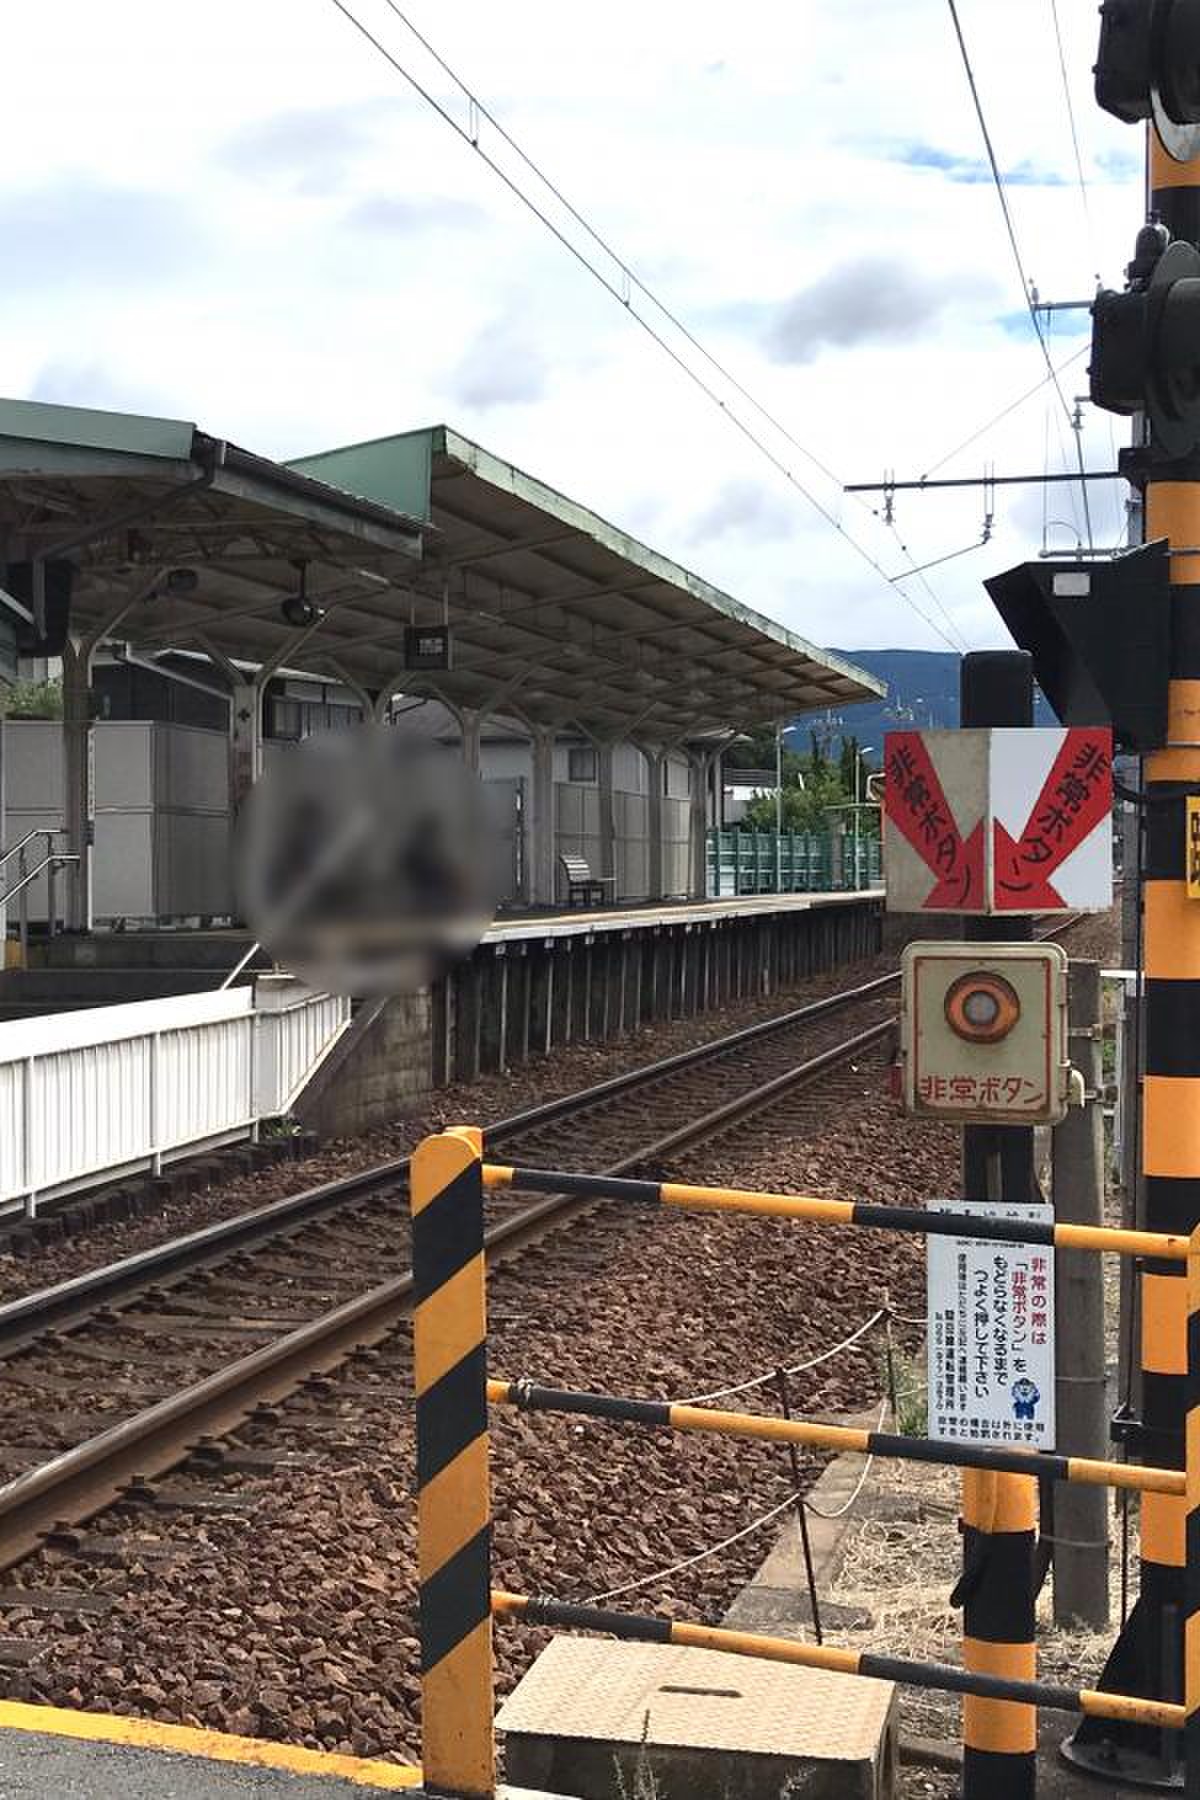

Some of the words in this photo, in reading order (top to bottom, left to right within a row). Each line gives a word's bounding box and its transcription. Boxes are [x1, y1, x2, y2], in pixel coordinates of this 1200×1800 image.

[919, 1075, 1044, 1104] 非常ボタン
[973, 1269, 990, 1398] つよく押して下さい
[993, 1255, 1008, 1386] もどらなくなるまで
[1011, 1262, 1029, 1373] 「非常ボタン」を
[1031, 1257, 1047, 1345] 非常の際は
